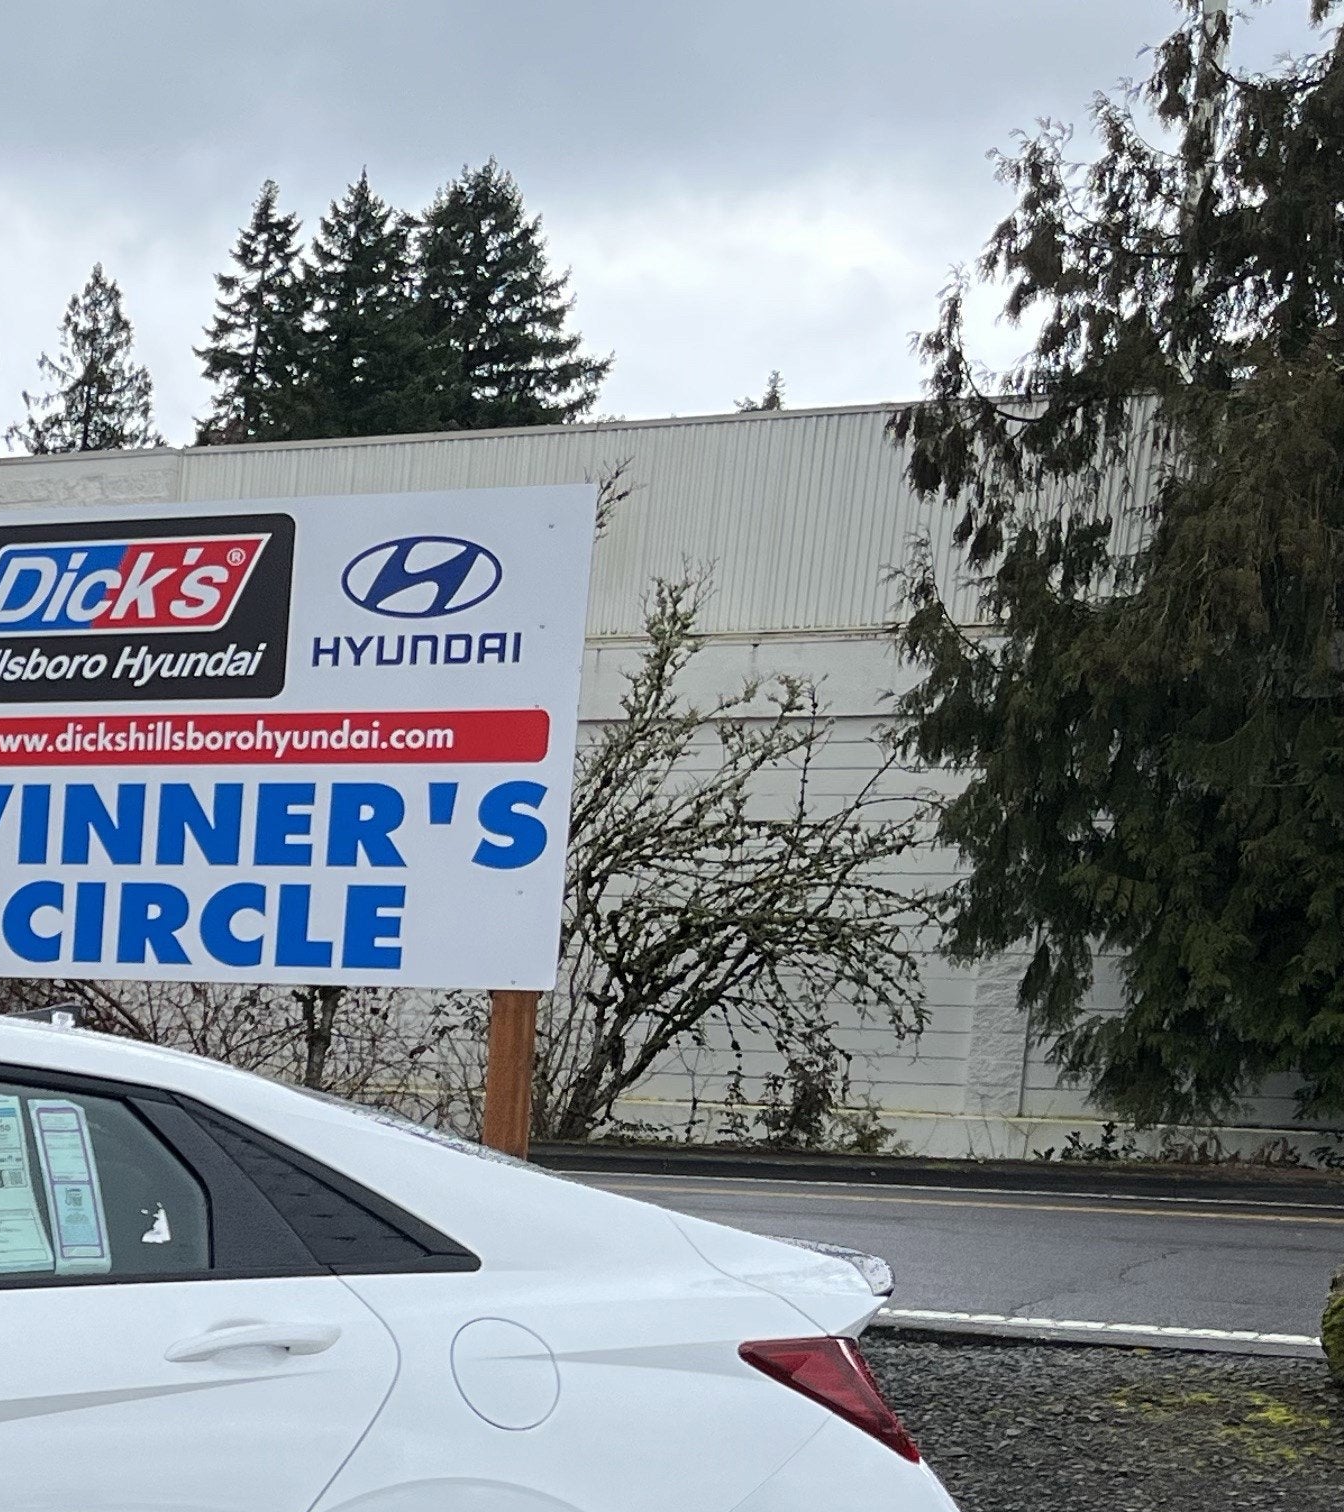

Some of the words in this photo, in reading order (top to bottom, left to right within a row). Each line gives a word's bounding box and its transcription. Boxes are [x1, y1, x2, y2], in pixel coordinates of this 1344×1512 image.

[111, 643, 268, 687] Hyundai
[311, 631, 523, 667] HYUNDAI
[1, 879, 406, 969] CIRCLE
